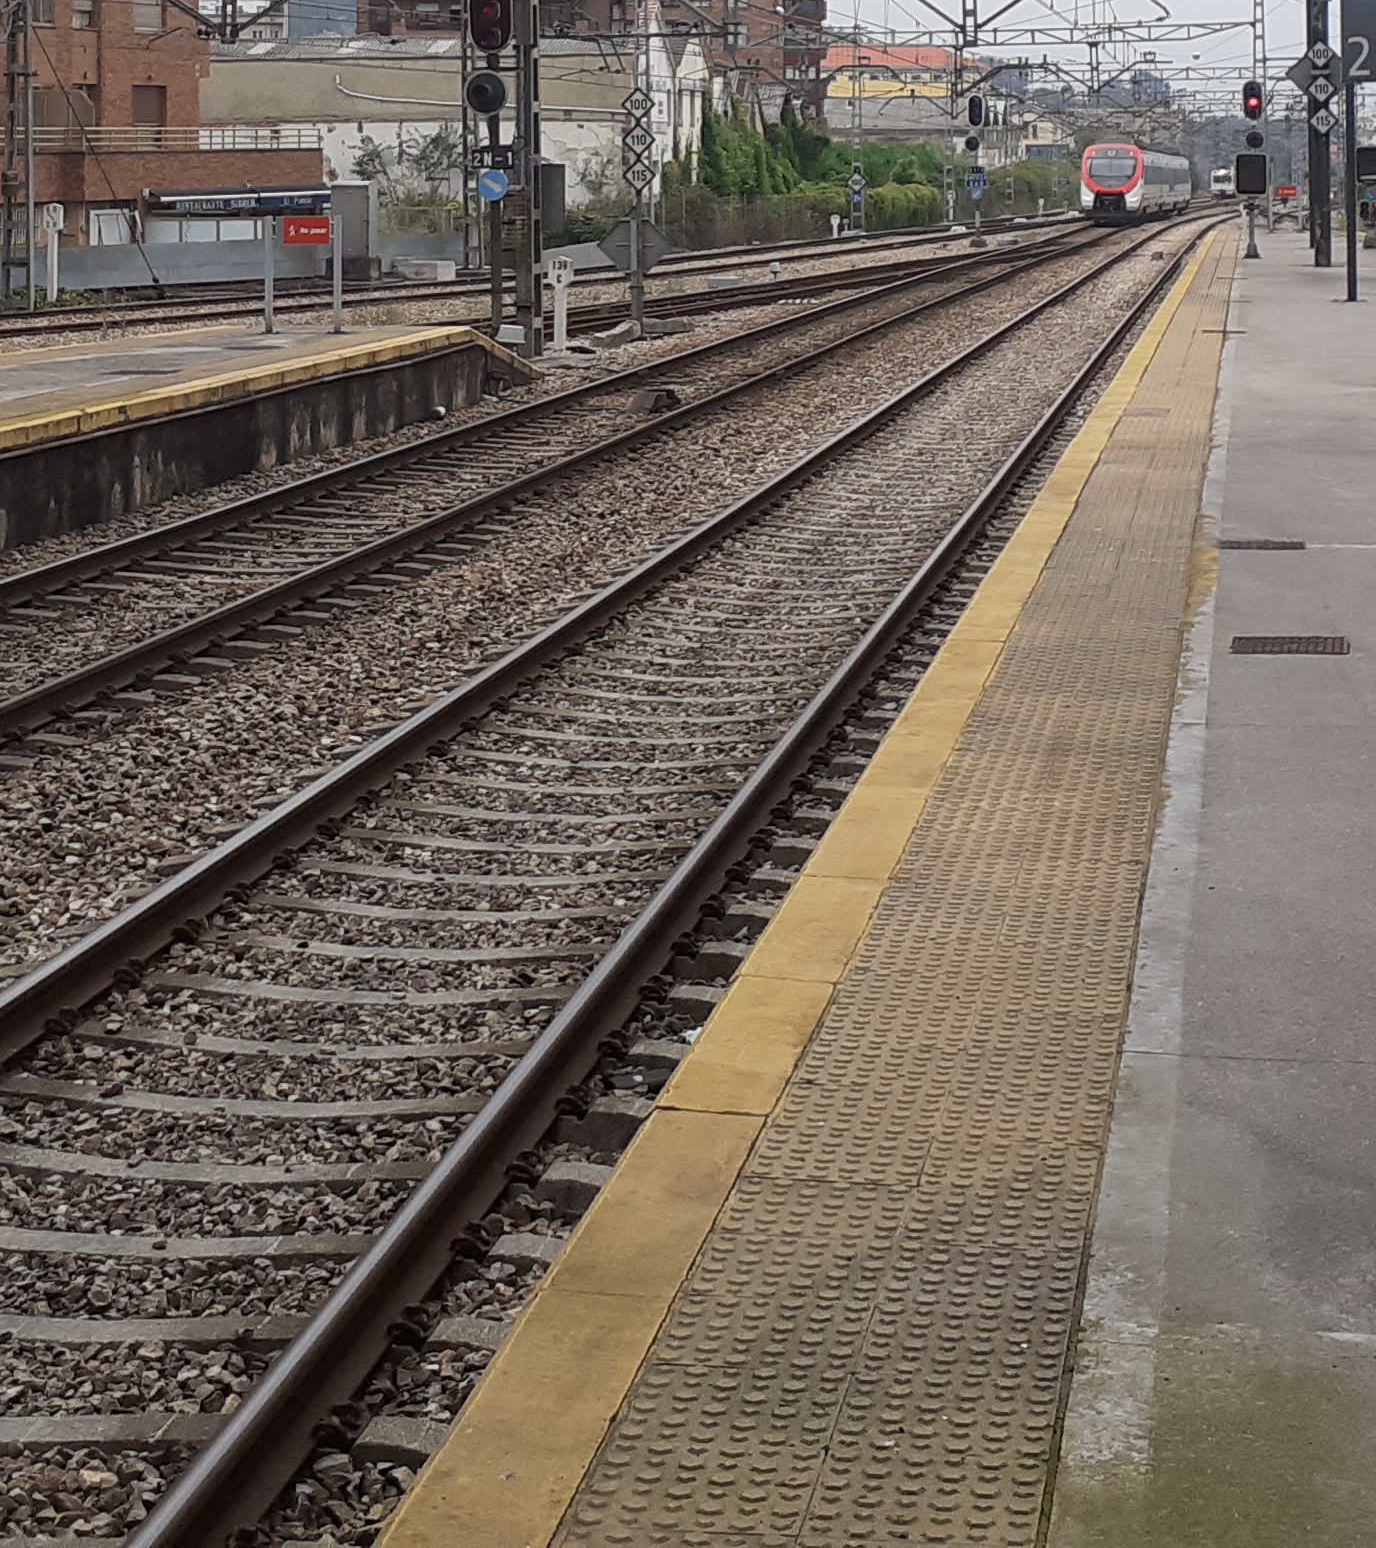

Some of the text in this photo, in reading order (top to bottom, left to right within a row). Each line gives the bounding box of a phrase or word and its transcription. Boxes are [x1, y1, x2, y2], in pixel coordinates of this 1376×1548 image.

[1312, 48, 1329, 60] 100
[1347, 36, 1371, 77] 2
[1314, 83, 1329, 95] 110
[629, 98, 648, 111] 100
[1316, 115, 1331, 127] 115
[630, 134, 647, 146] 110
[473, 152, 514, 166] 2N-1
[631, 169, 647, 182] 115
[175, 200, 224, 211] RESTAURANTE
